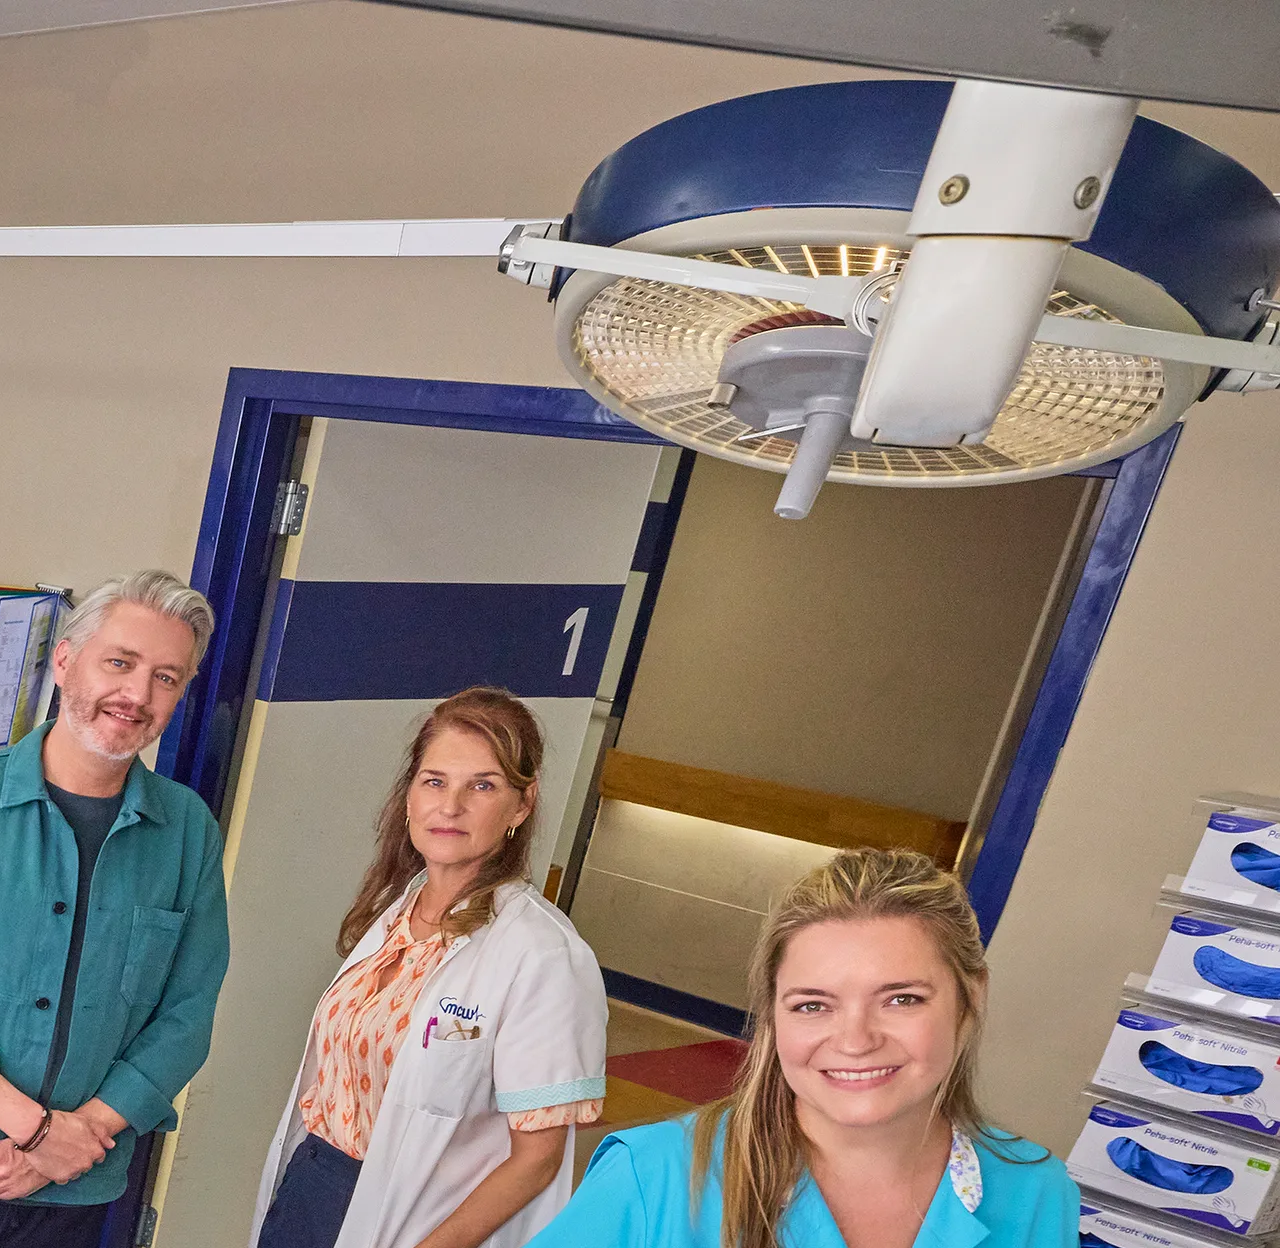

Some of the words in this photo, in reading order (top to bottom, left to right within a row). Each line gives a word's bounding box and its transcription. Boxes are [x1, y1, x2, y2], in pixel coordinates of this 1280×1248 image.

[562, 607, 589, 675] 1
[1219, 1042, 1248, 1056] Nitrile
[1191, 1142, 1219, 1156] Nitrile
[1142, 1232, 1172, 1247] Nitrile
